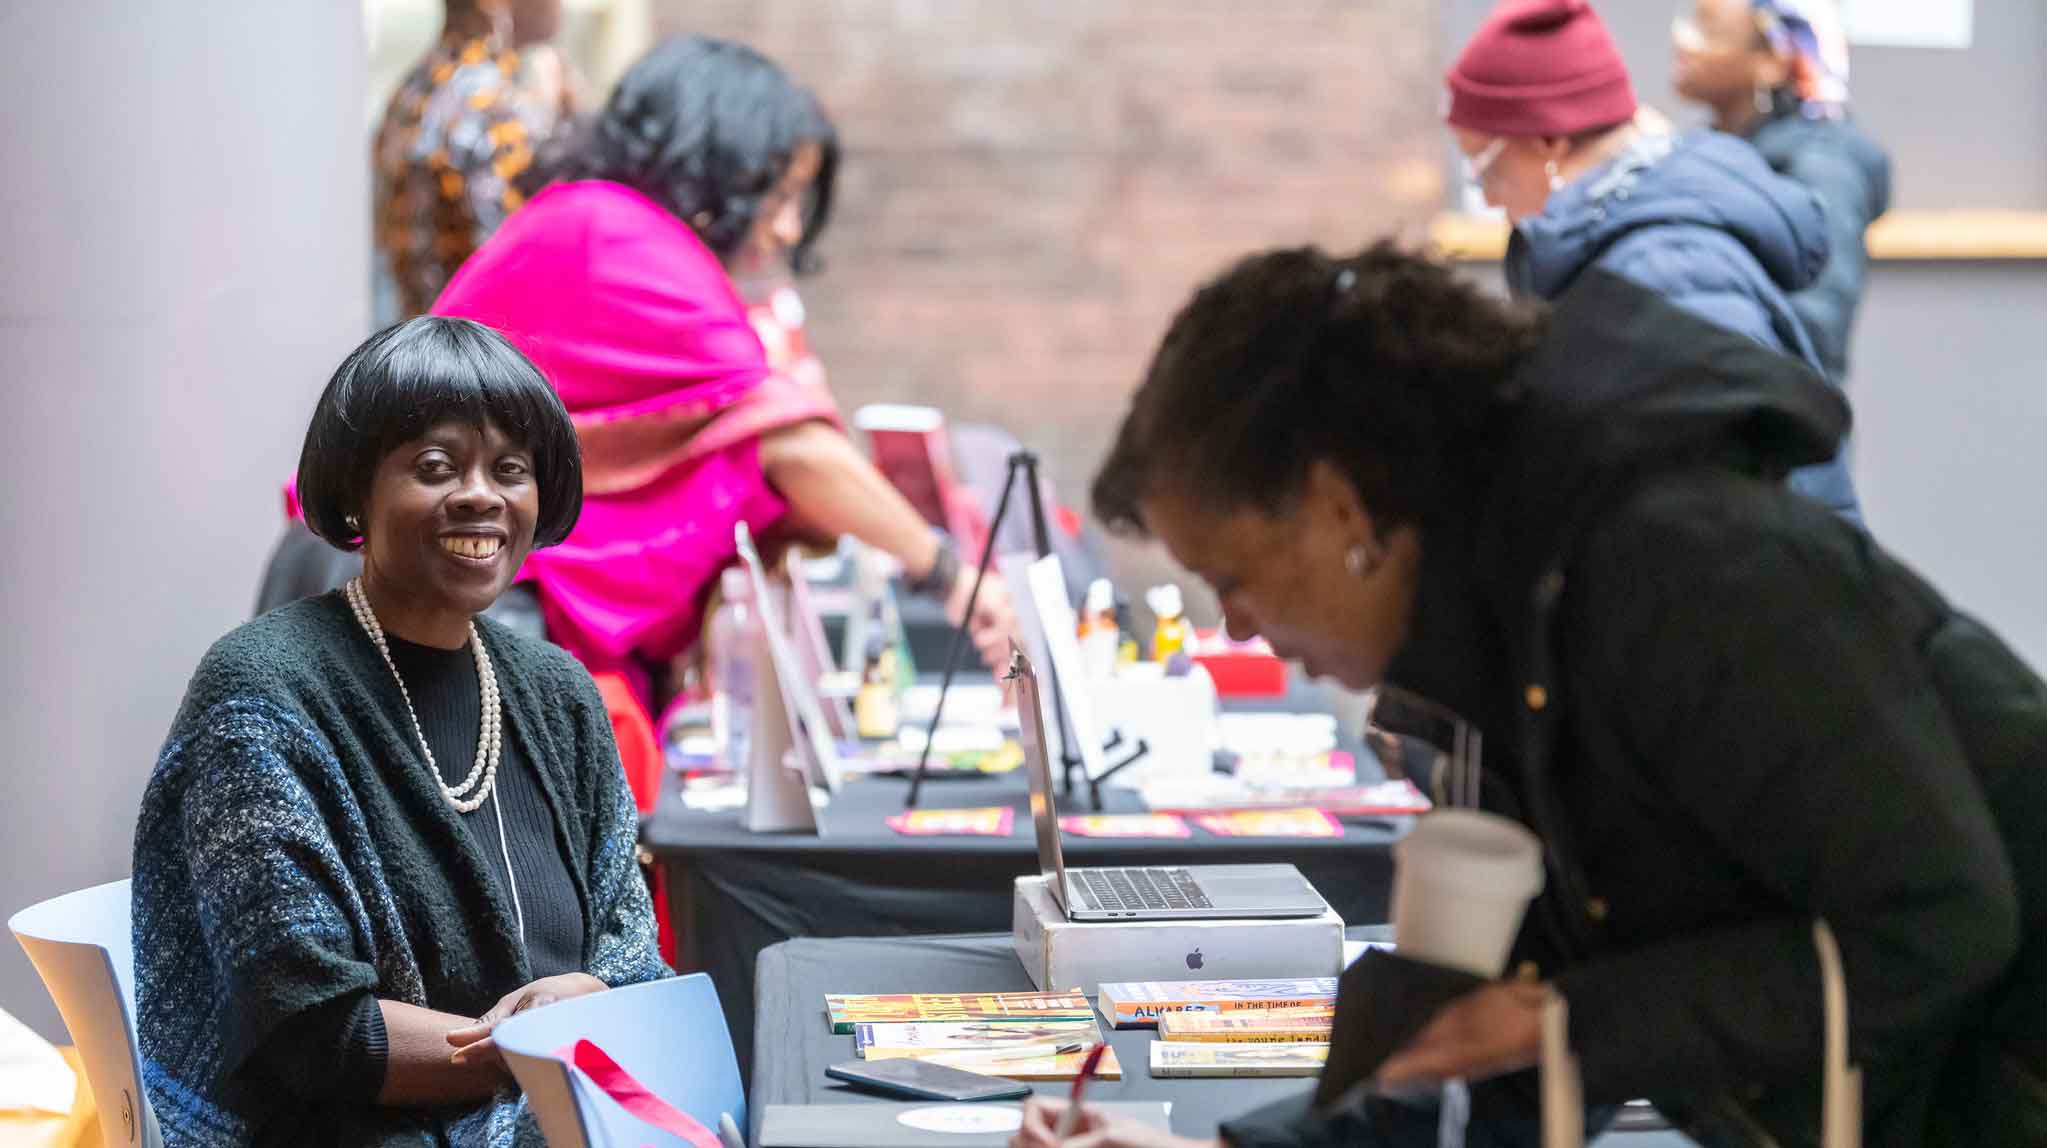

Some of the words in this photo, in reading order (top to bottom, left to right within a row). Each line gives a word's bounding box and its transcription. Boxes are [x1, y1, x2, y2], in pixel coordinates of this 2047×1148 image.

[1234, 1001, 1243, 1009] IN
[1247, 1001, 1264, 1009] THE
[1266, 1001, 1288, 1009] TIME
